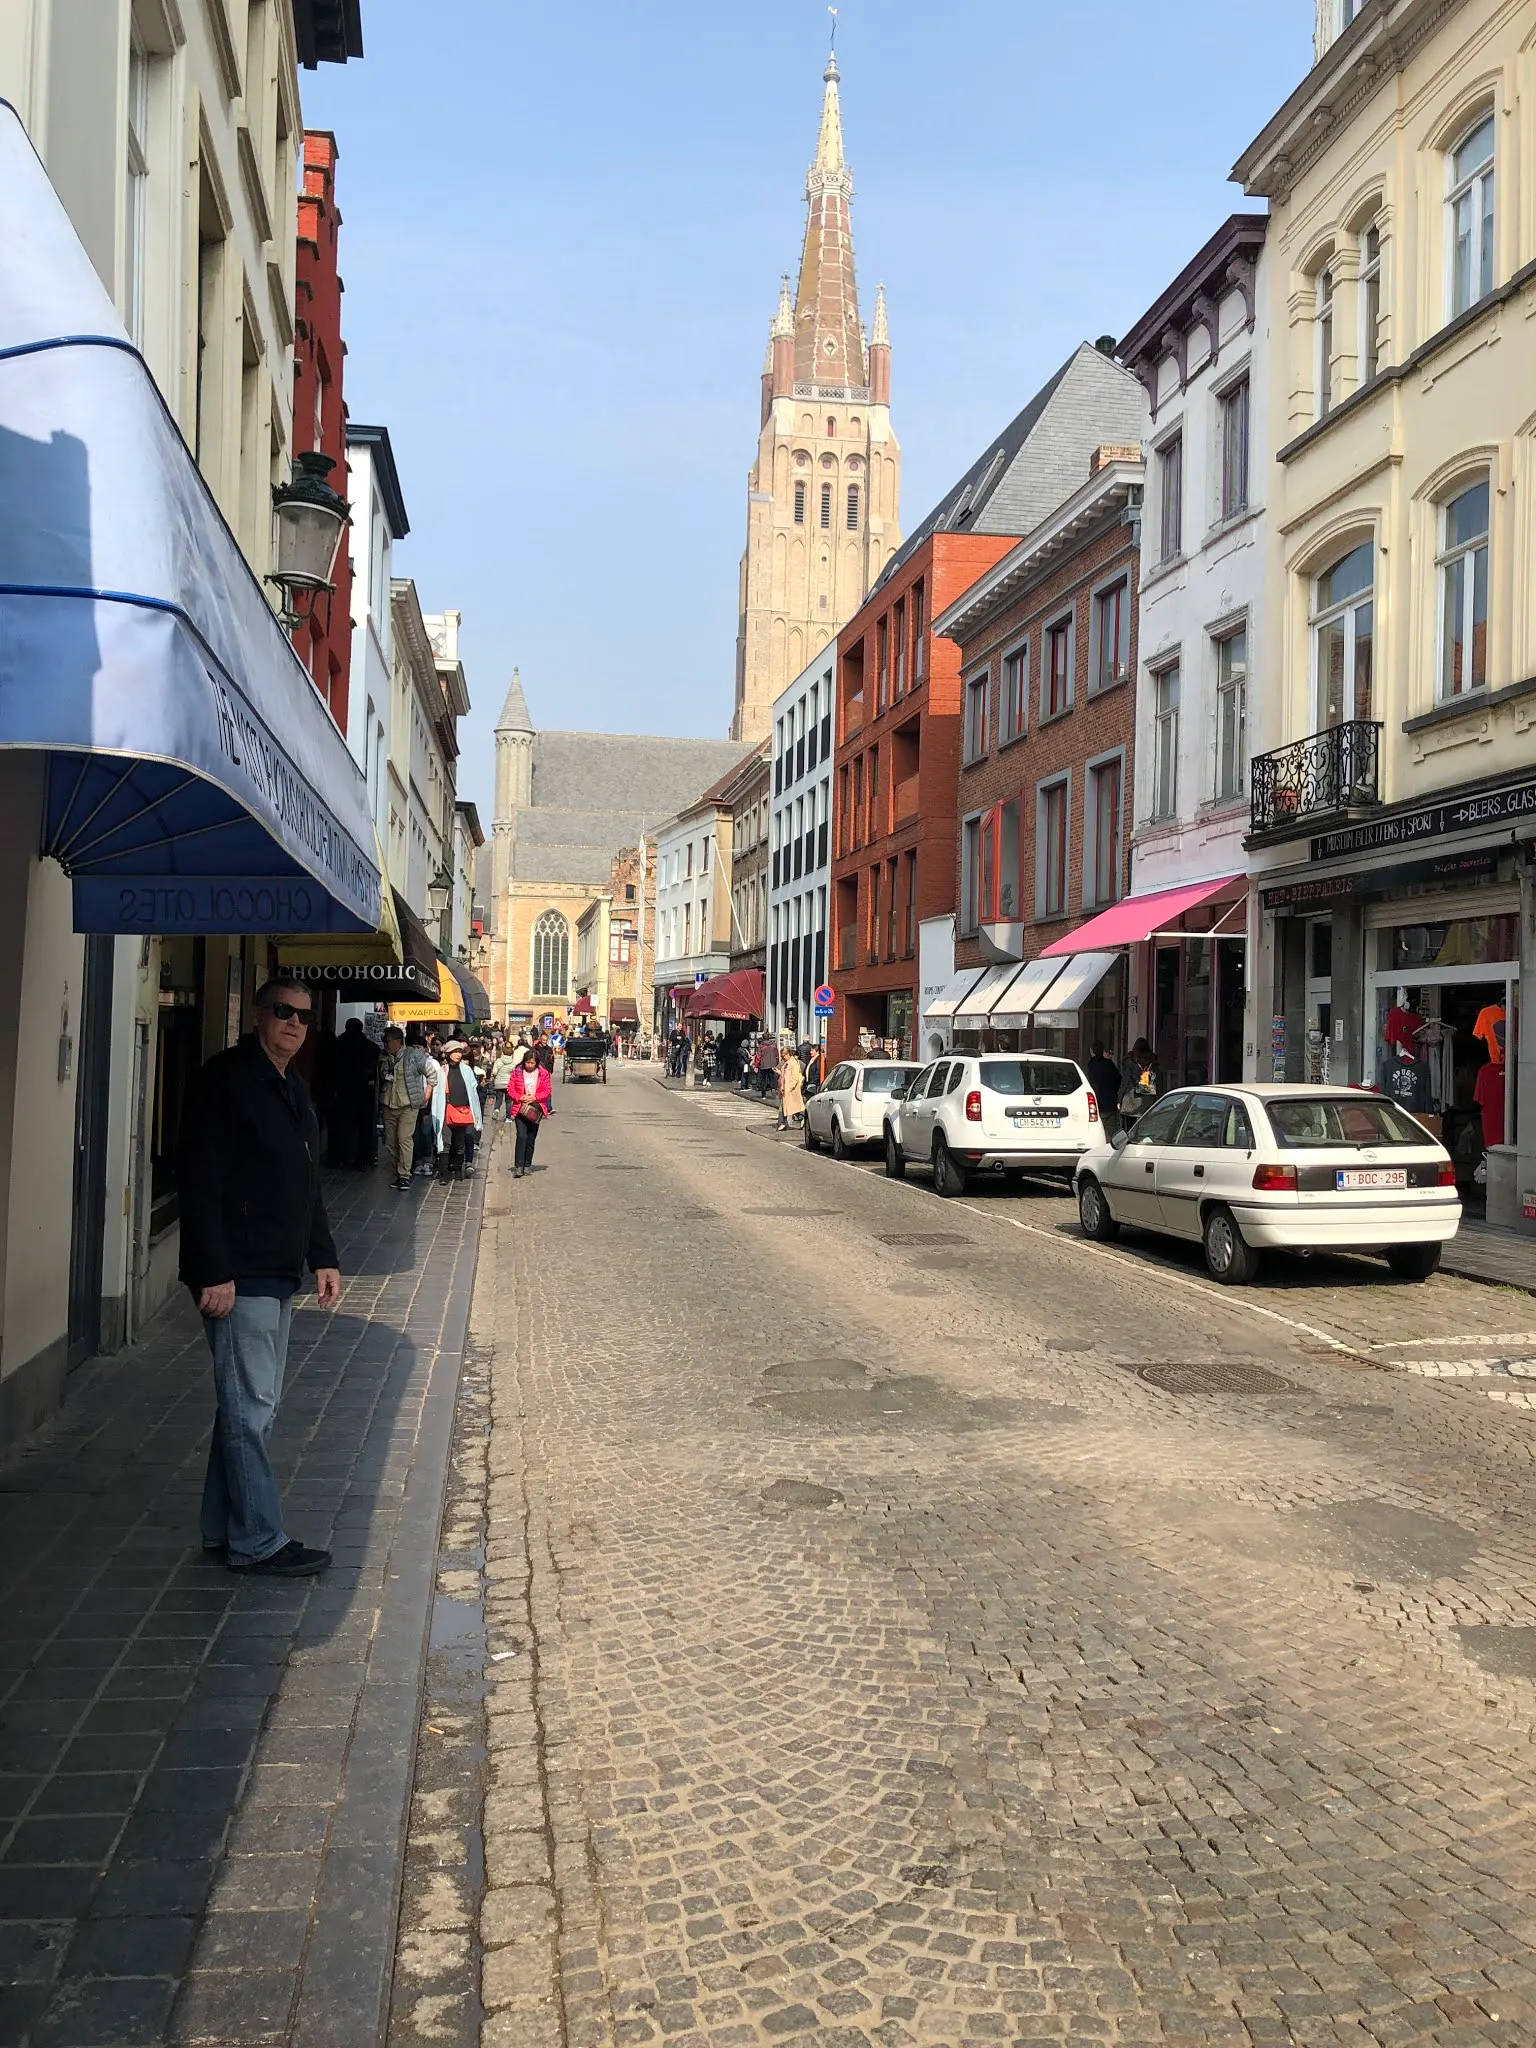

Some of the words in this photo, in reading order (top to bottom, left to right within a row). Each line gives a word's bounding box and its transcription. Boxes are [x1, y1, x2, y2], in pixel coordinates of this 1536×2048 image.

[1407, 813, 1432, 835] SPORT
[278, 965, 415, 980] CHOCOHOLIC
[408, 1008, 450, 1016] WAFFLES
